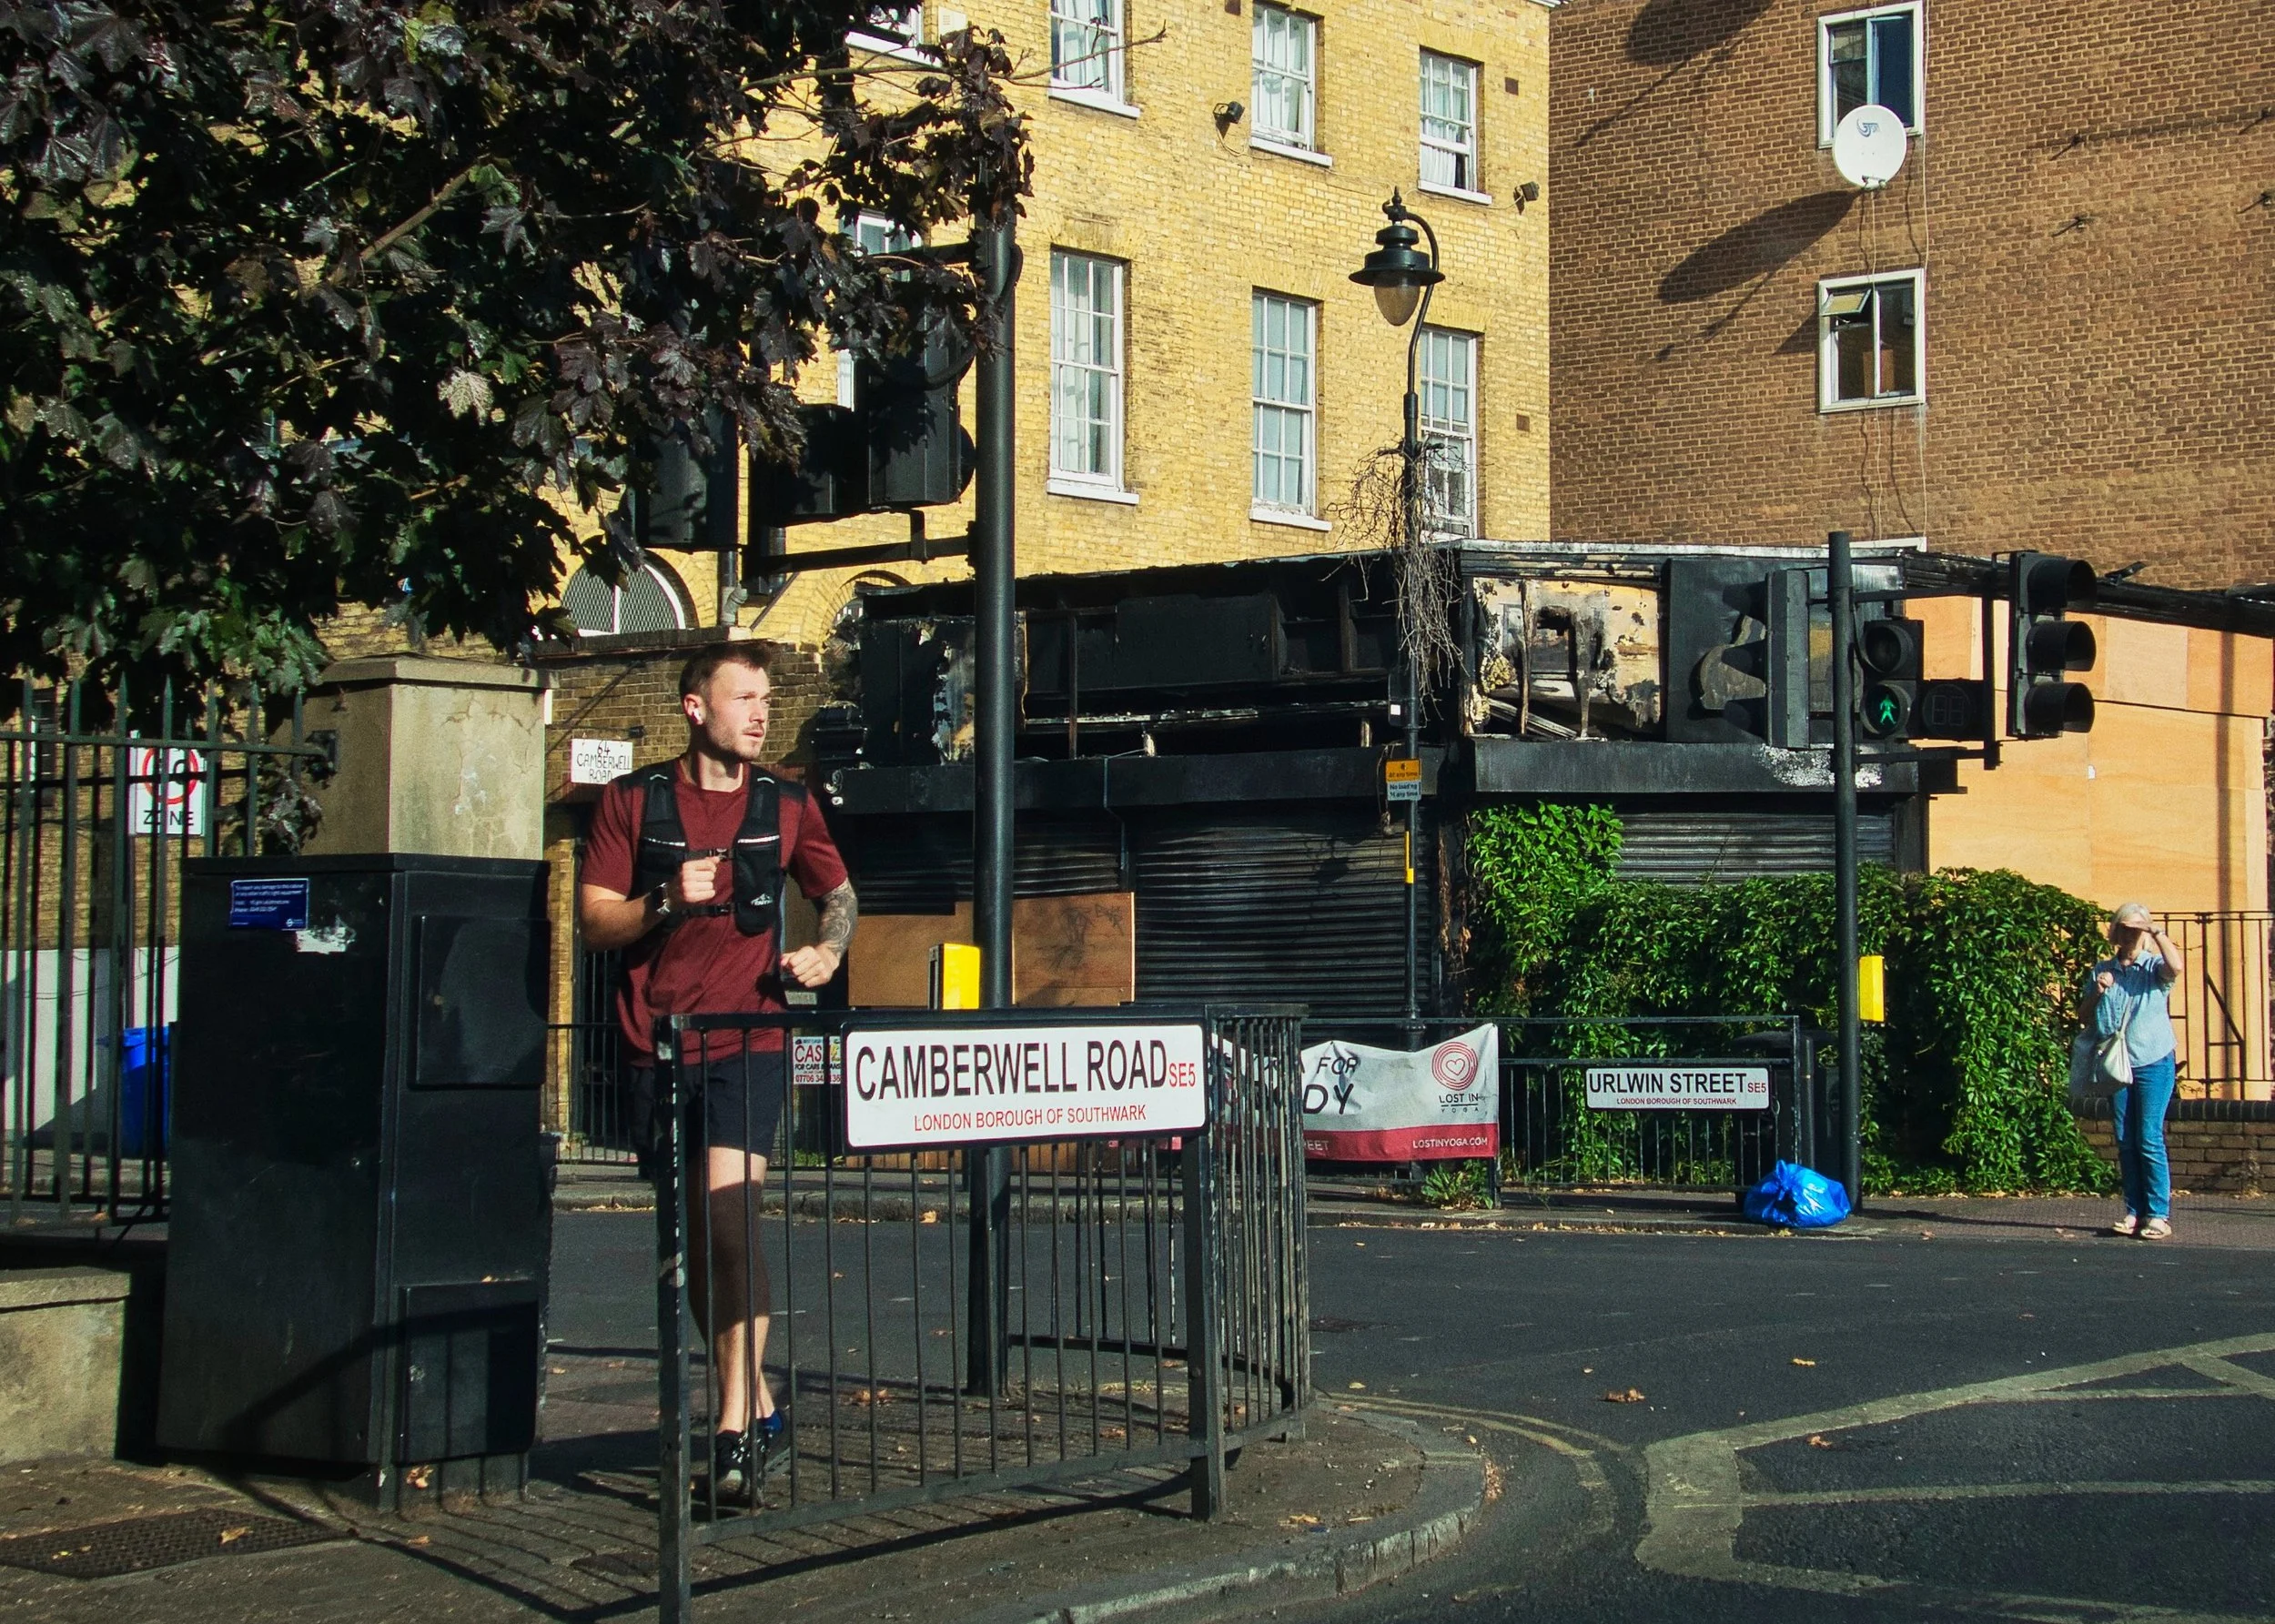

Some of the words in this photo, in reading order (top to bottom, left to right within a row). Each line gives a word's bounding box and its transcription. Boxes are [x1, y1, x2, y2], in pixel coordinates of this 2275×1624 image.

[597, 740, 611, 755] 64
[576, 752, 632, 771] CAMBERWELL
[589, 768, 613, 783] ROAD
[143, 810, 194, 826] ZNE
[855, 1042, 1077, 1101] CAMBERWELL
[1087, 1039, 1167, 1092] ROAD
[1168, 1063, 1196, 1087] SE5
[1317, 1056, 1359, 1075] FOR
[1589, 1073, 1663, 1094] URLWIN
[1670, 1073, 1747, 1094] STREET
[1747, 1083, 1767, 1094] SE5
[1439, 1094, 1465, 1104] LOST
[1468, 1093, 1479, 1103] IN
[1616, 1097, 1645, 1105] LONDON
[1646, 1097, 1681, 1105] BOROUGH
[1682, 1097, 1692, 1105] OF
[1693, 1097, 1737, 1105] SOUTHWARK
[914, 1113, 971, 1132] LONDON
[976, 1109, 1043, 1128] BOROUGH
[1046, 1107, 1063, 1125] OF
[1067, 1104, 1147, 1124] SOUTHWARK
[1411, 1136, 1489, 1149] LOSTINYOGA.COM
